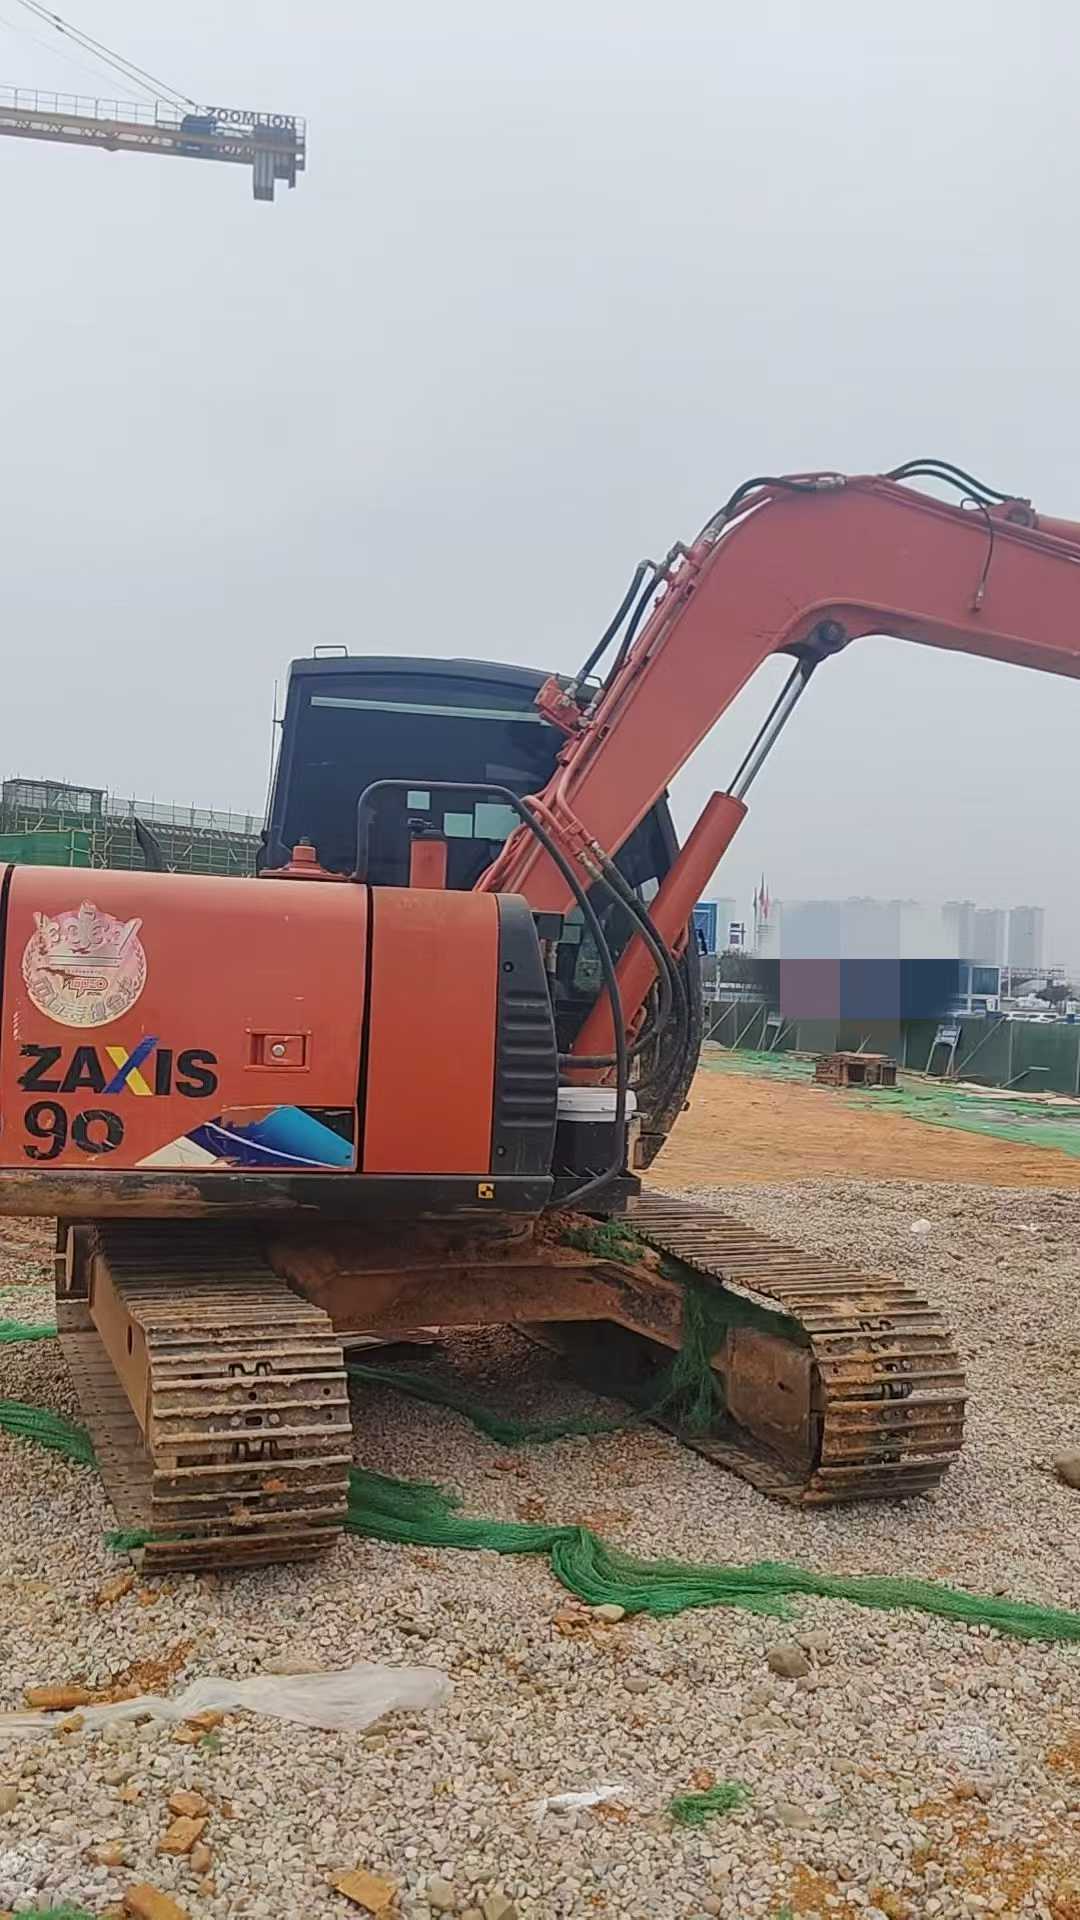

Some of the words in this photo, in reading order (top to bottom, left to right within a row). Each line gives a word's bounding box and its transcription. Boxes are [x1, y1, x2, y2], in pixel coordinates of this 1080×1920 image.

[206, 106, 296, 130] ZOOMLION
[17, 1035, 218, 1098] ZAXIS
[23, 1100, 124, 1160] 90
